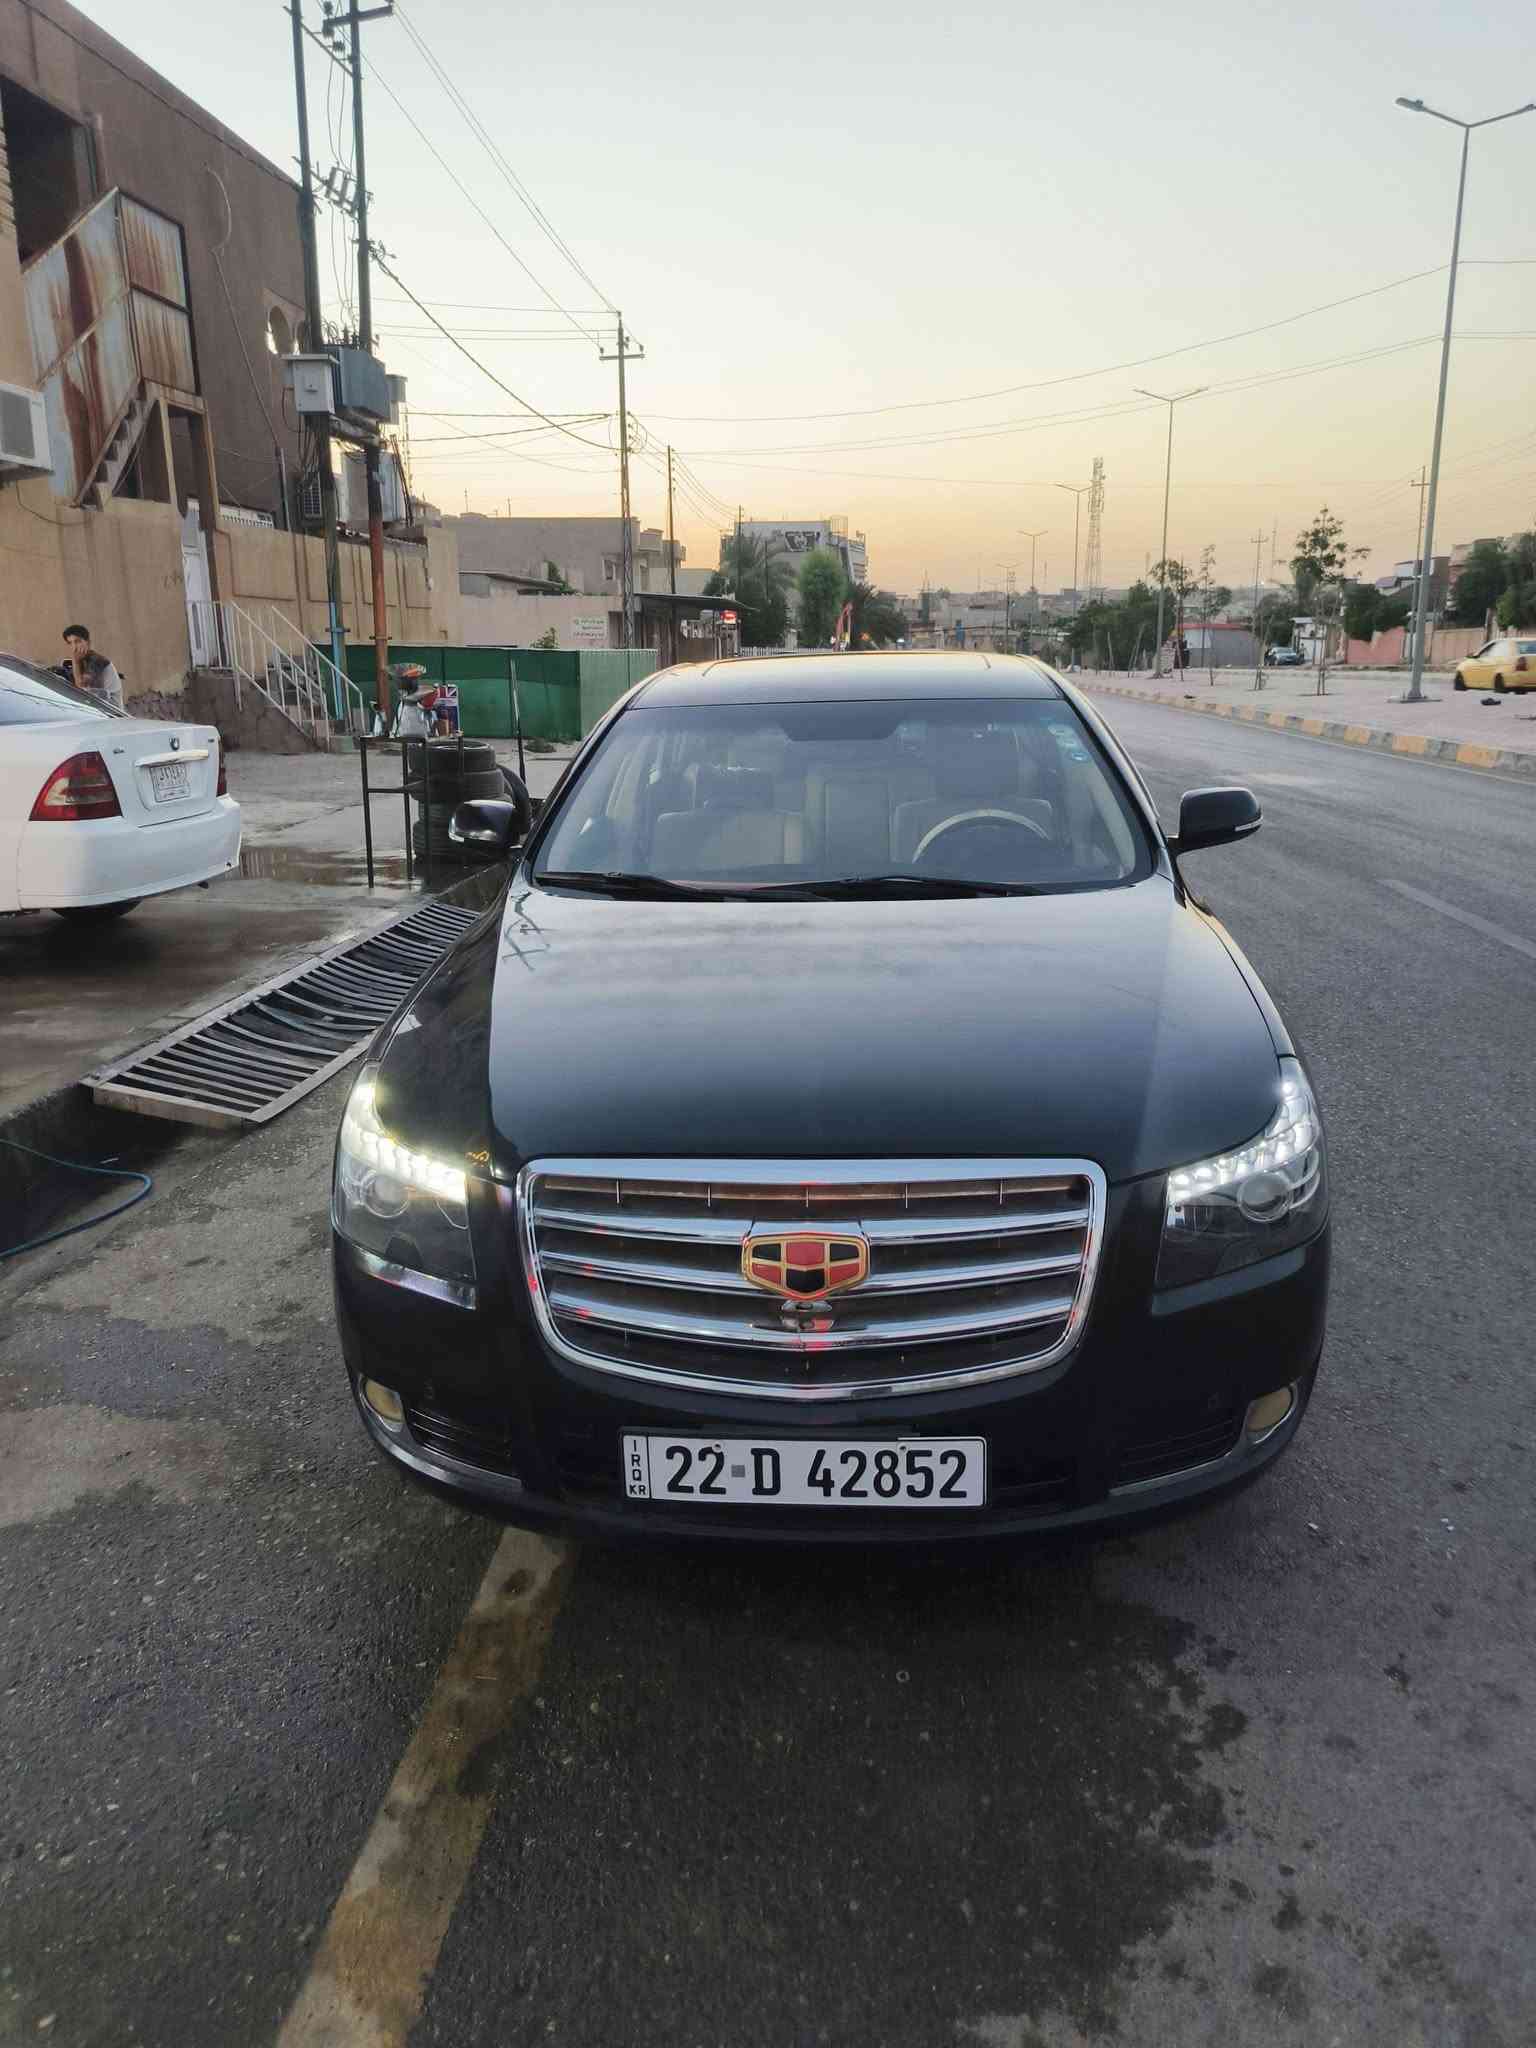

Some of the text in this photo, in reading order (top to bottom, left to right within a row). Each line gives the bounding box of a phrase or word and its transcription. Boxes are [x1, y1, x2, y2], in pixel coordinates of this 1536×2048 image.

[665, 1445, 967, 1498] 22 D 42852
[629, 1484, 646, 1495] KR
